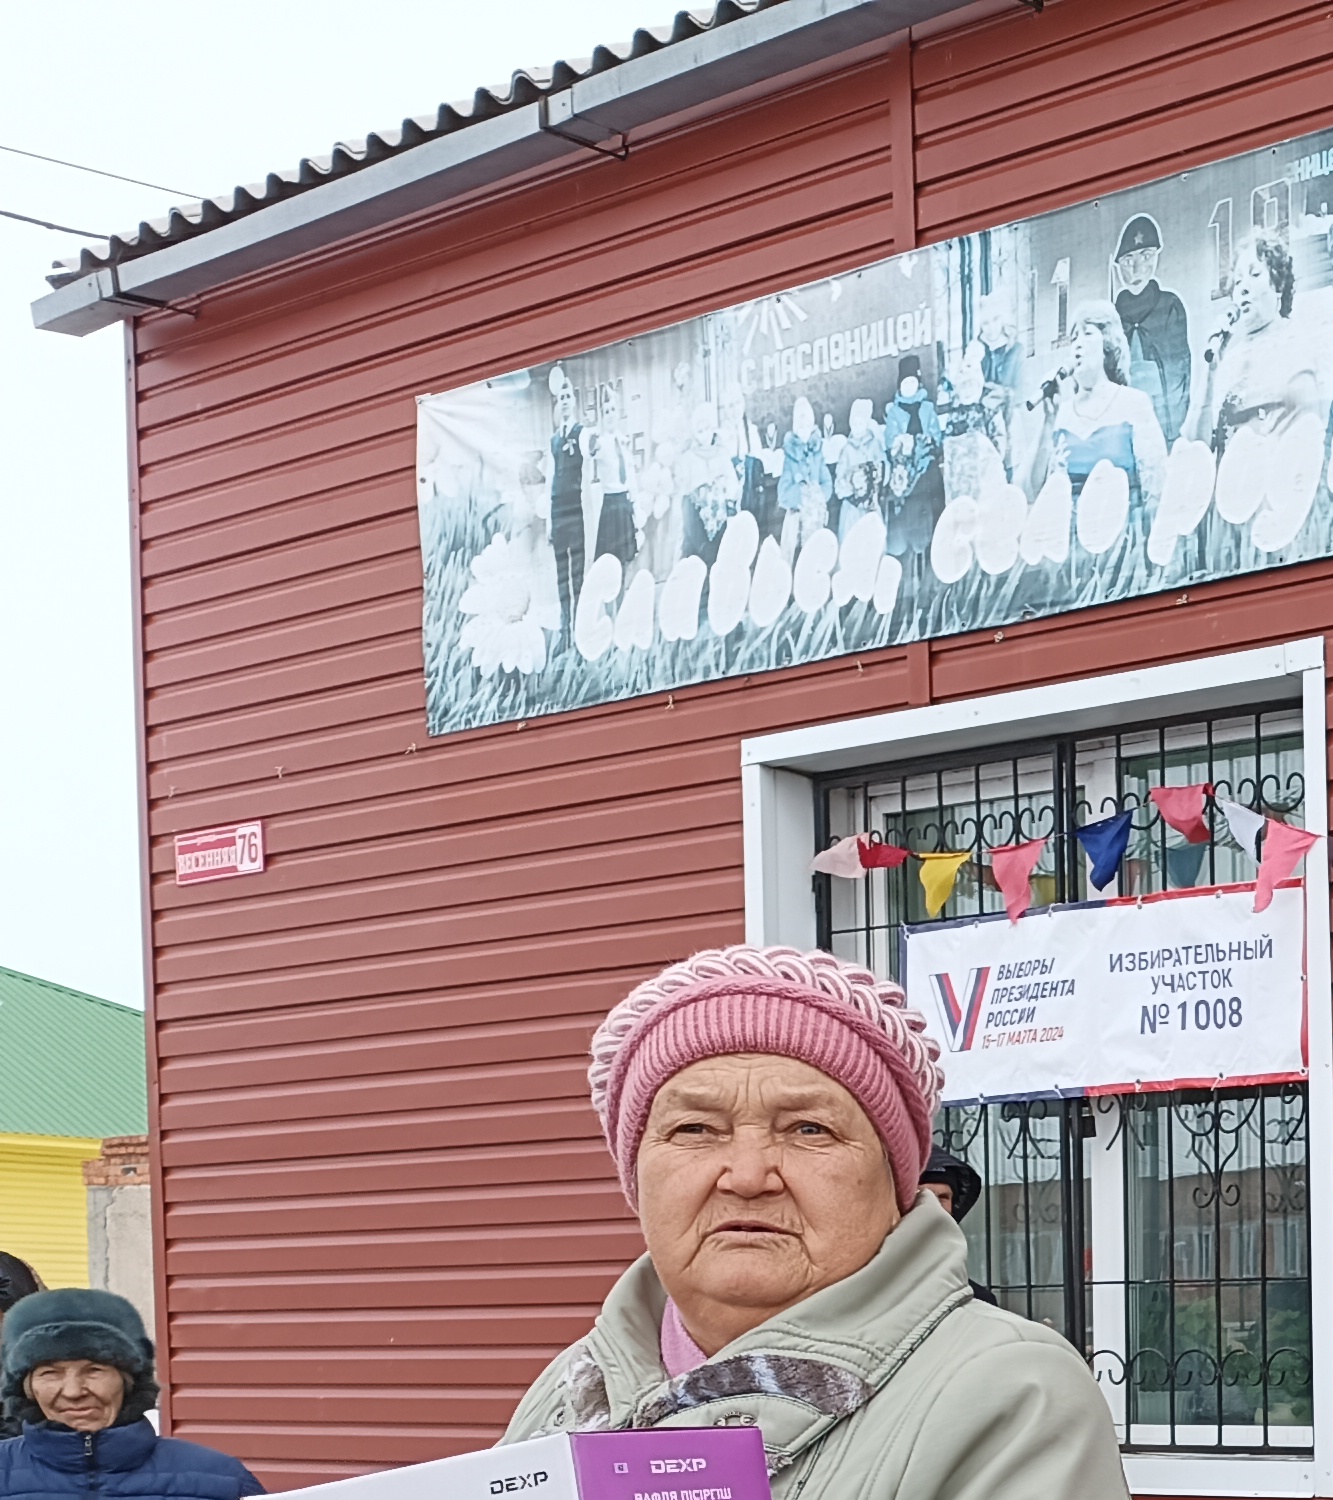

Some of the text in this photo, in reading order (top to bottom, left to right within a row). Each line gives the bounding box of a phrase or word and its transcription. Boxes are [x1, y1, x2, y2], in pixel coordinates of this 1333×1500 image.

[238, 831, 258, 865] 76
[1108, 934, 1274, 974] ИЗБИРАТЕЛЬНЫЙ
[997, 957, 1055, 982] ВЫБОРЫ
[1151, 967, 1234, 995] УЧАСТОК
[991, 979, 1076, 1005] ПРЕЗИДЕНТА
[985, 1006, 1036, 1029] РОССИИ
[1140, 996, 1243, 1035] № 1008
[1006, 1028, 1039, 1048] МАРТА
[1039, 1025, 1065, 1045] 2024
[649, 1457, 707, 1474] DEXP
[490, 1471, 549, 1495] DEXP
